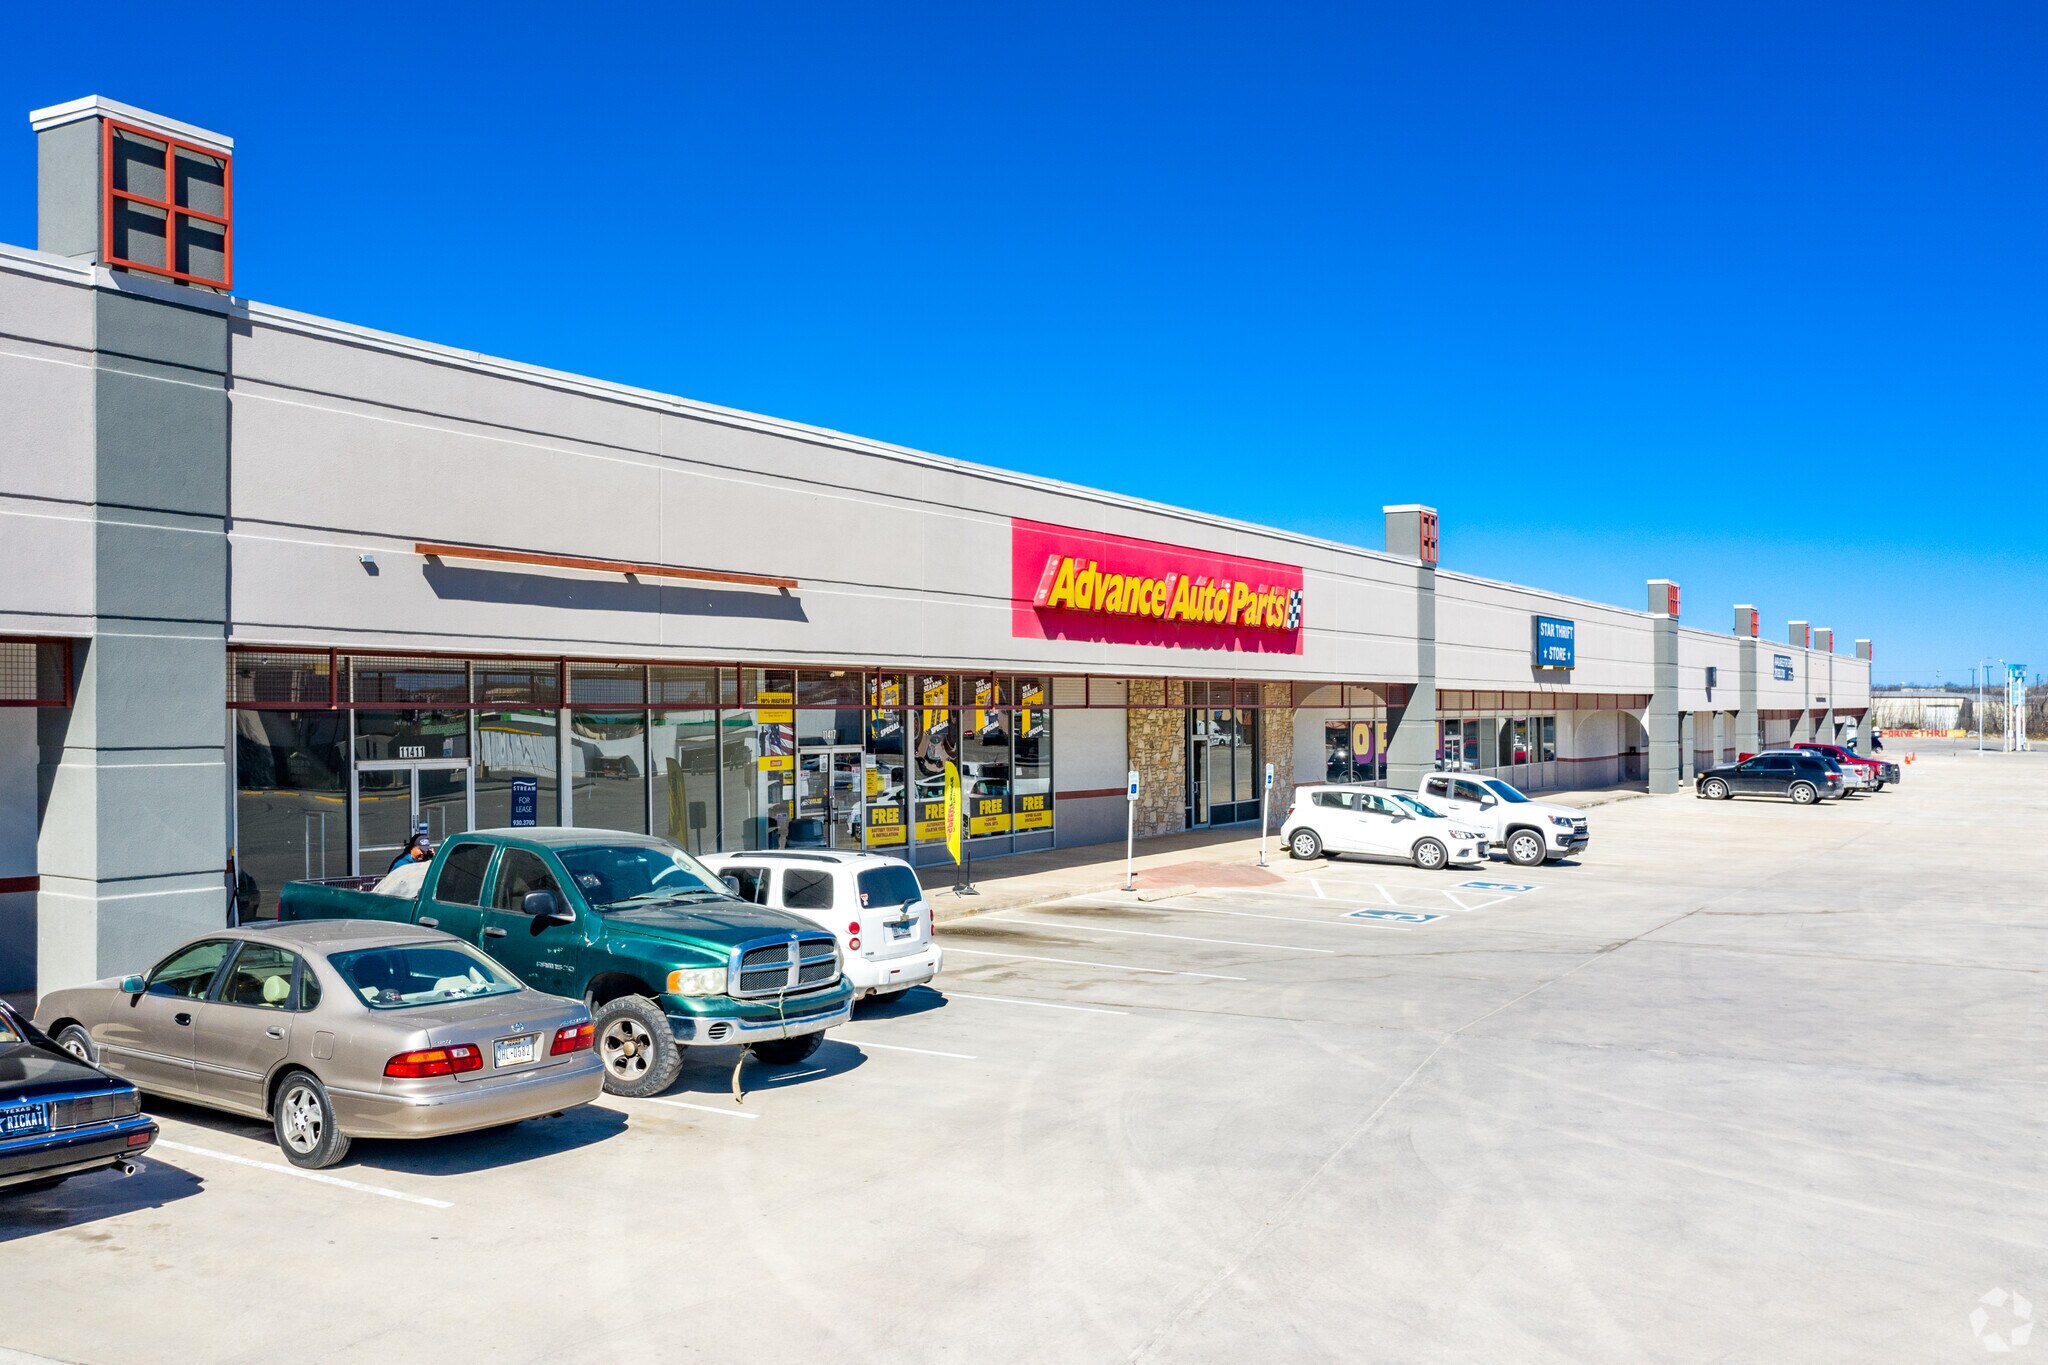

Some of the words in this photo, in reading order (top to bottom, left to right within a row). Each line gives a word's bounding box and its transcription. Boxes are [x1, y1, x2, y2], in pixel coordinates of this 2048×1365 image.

[1047, 557, 1167, 618] Advance
[1167, 574, 1229, 623] Auto
[1229, 581, 1286, 628] Parts
[1540, 622, 1555, 637] STAR
[1555, 624, 1573, 639] THRIFT
[1549, 646, 1566, 661] STORE
[924, 676, 934, 685] TAX
[924, 680, 942, 693] SEASON
[976, 679, 985, 688] TAX
[1022, 684, 1031, 692] TAX
[1022, 687, 1038, 698] SEASON
[881, 722, 899, 737] SPECIAL
[931, 720, 948, 734] SPECIAL
[983, 720, 999, 734] SPECIAL
[1029, 724, 1043, 737] SPECIAL
[822, 729, 836, 740] 11417
[400, 746, 425, 758] 11411
[519, 796, 531, 804] FOR
[980, 798, 1002, 815] FREE
[1023, 795, 1044, 811] FREE
[872, 807, 899, 824] FREE
[925, 803, 945, 820] FRE
[5, 1105, 31, 1115] TEXAS
[7, 1111, 42, 1130] RICKAT
